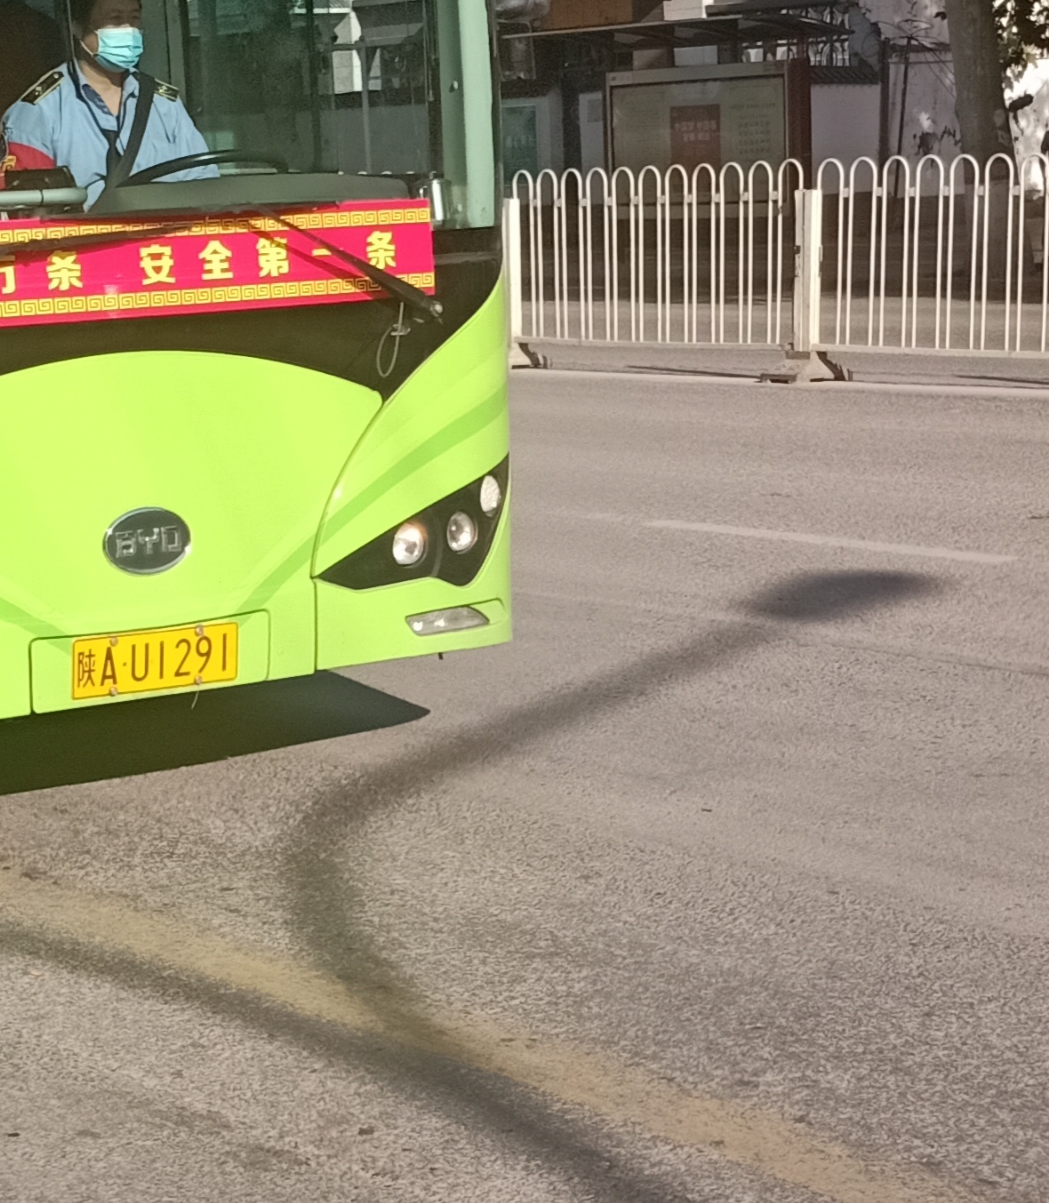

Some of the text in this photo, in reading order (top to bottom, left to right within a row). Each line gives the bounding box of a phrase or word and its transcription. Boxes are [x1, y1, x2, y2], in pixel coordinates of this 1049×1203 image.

[140, 230, 398, 286] 安全第一条
[115, 525, 182, 559] BYD
